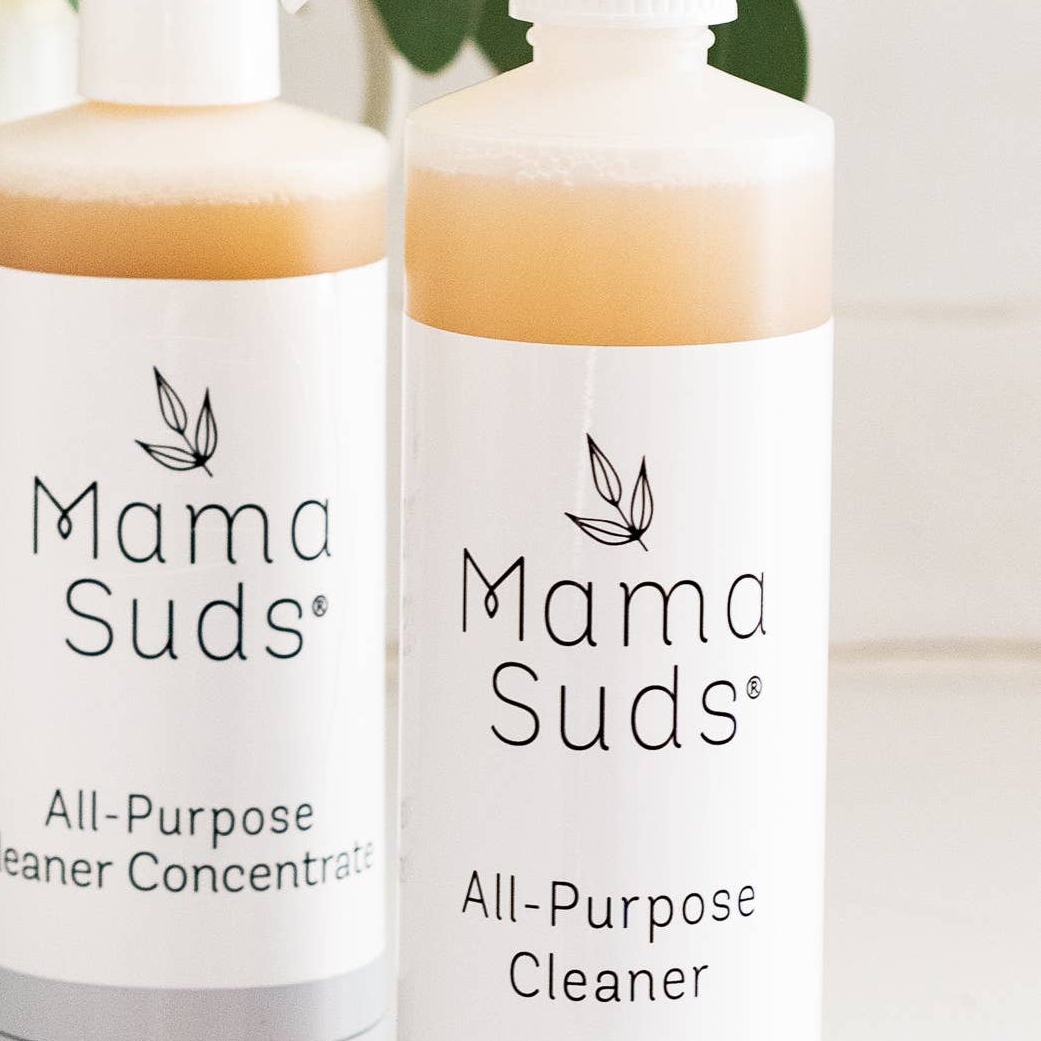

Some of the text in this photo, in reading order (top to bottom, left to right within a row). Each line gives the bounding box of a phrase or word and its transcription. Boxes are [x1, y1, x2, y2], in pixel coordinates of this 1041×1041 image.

[33, 476, 331, 564] Mama
[462, 548, 766, 647] Mama
[45, 788, 314, 849] All-Purpose
[128, 839, 375, 893] Concentrate
[462, 870, 756, 944] All-Purpose
[510, 951, 709, 1002] Cleaner
